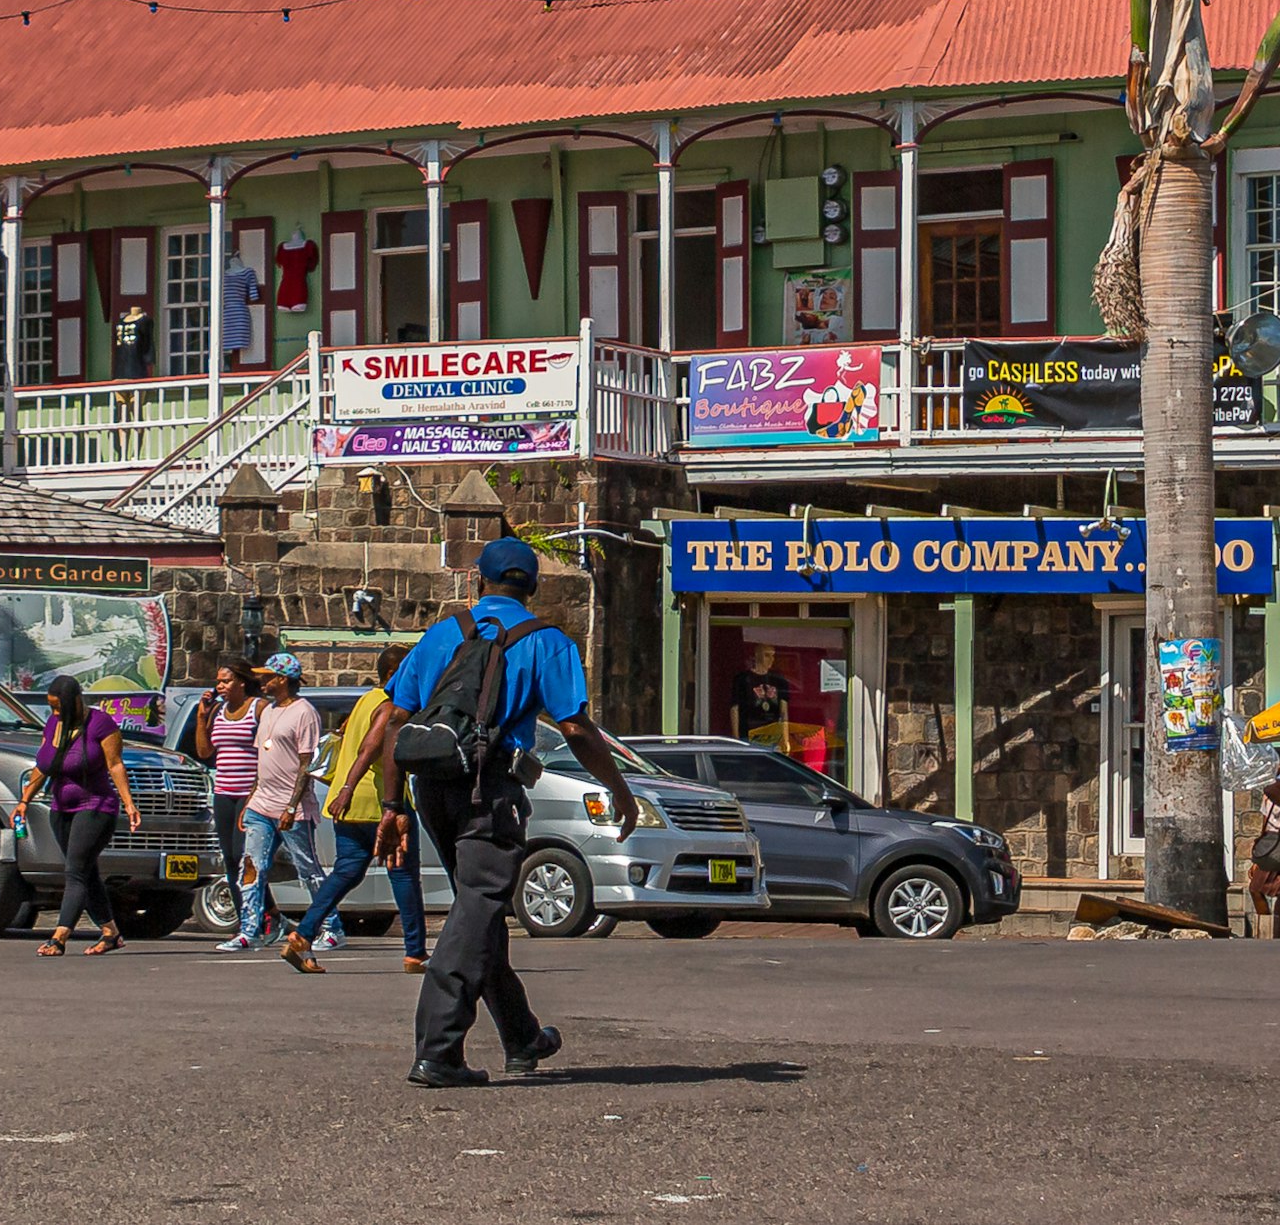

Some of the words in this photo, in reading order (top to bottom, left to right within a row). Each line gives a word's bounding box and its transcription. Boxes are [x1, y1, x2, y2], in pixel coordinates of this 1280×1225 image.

[363, 349, 548, 380] SMILECARE
[968, 367, 984, 382] go
[987, 359, 1078, 384] CASHLESS
[1081, 365, 1118, 382] today
[1120, 364, 1141, 379] wit
[696, 355, 815, 394] FABZ
[392, 382, 455, 399] DENTAL
[460, 380, 514, 396] CLINIC
[1220, 386, 1252, 402] 2729
[401, 403, 415, 413] Dr.
[417, 401, 466, 413] Hemalatha
[468, 400, 506, 411] Aravind
[694, 395, 807, 420] Boutique
[352, 433, 388, 452] Cleo
[403, 426, 469, 440] MASSAGE
[481, 426, 526, 440] FACIAL
[401, 440, 440, 453] NAILS
[451, 439, 504, 453] WAXING
[686, 540, 772, 572] THE
[784, 539, 900, 572] POLO
[49, 563, 143, 583] Gardens
